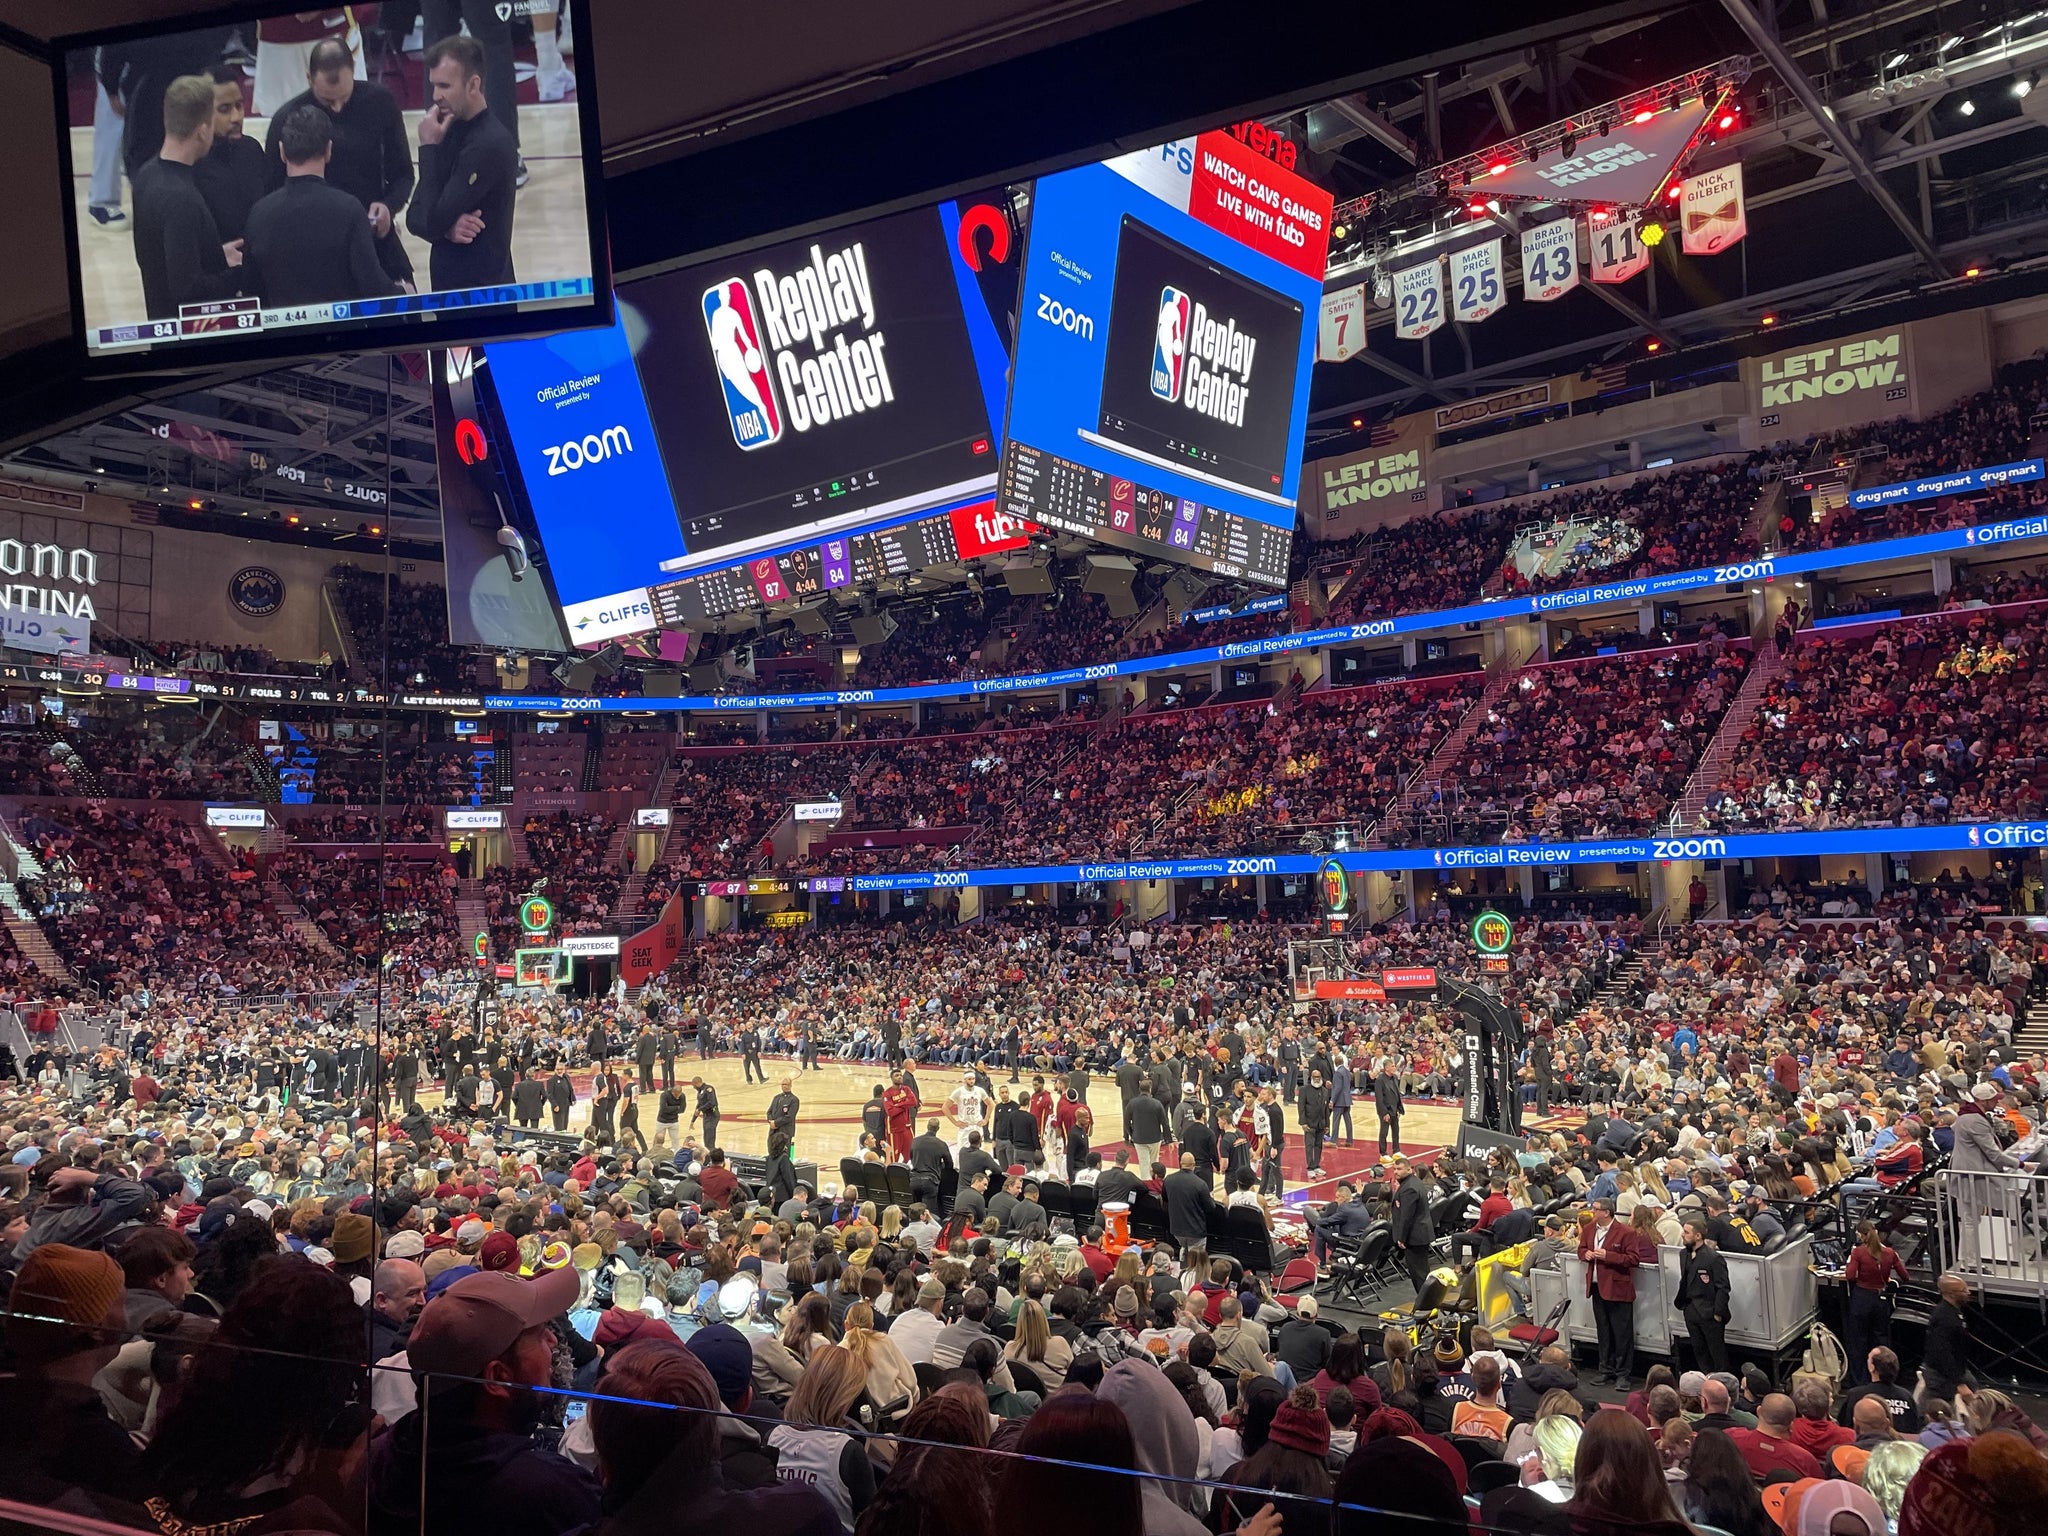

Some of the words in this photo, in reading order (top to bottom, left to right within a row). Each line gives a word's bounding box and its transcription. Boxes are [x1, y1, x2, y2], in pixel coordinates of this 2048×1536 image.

[1535, 157, 1586, 179] LET
[1585, 142, 1635, 163] EM
[1550, 151, 1658, 188] KNOW.
[1696, 173, 1724, 188] NICK
[1204, 152, 1246, 190] WATCH
[1248, 179, 1280, 209] CAVS
[1282, 198, 1322, 231] GAMES
[1688, 180, 1735, 202] GILBERT
[1216, 188, 1242, 216] LIVE
[1244, 202, 1273, 232] WITH
[1275, 217, 1305, 248] fubo
[1534, 226, 1562, 240] BRAD
[1523, 232, 1574, 254] DAUGHERTY
[1600, 226, 1637, 268] 11
[1462, 248, 1490, 264] MARK
[1463, 256, 1490, 274] PRICE
[1050, 250, 1070, 272] Official
[1071, 262, 1092, 281] Review
[1530, 246, 1572, 288] 43
[1403, 267, 1432, 283] LARRY
[1403, 276, 1434, 292] NANCE
[752, 241, 876, 351] Replay
[1458, 267, 1498, 310] 25
[1328, 301, 1354, 316] SMITH
[1400, 288, 1439, 328] 22
[237, 314, 256, 327] 87
[264, 314, 279, 324] 3RD
[284, 311, 307, 322] 4:44
[1037, 294, 1094, 342] zoom
[153, 323, 173, 337] 84
[1334, 314, 1349, 346] 7
[1190, 301, 1256, 382] Replay
[1762, 347, 1832, 382] LET
[1838, 334, 1900, 368] EM
[536, 383, 569, 403] Official
[569, 373, 601, 396] Review
[777, 331, 895, 432] Center
[1153, 368, 1170, 395] NBA
[1762, 360, 1906, 408] KNOW.
[555, 395, 581, 410] presented
[1185, 360, 1250, 428] Center
[1886, 388, 1907, 400] 225
[737, 408, 764, 440] NBA
[1762, 415, 1780, 427] 224
[542, 425, 633, 476] zoom
[1324, 460, 1374, 488] LET
[1378, 449, 1419, 475] EM
[1980, 471, 2006, 482] drug
[2008, 464, 2037, 476] mart
[1326, 469, 1426, 510] KNOW.
[1916, 482, 1942, 494] drug
[1944, 476, 1972, 488] mart
[1136, 491, 1148, 504] 3Q
[1411, 491, 1426, 502] 223
[1856, 492, 1881, 504] drug
[1882, 486, 1908, 498] mart
[1164, 500, 1173, 511] 14
[1114, 509, 1130, 528] 87
[1326, 510, 1340, 520] 222
[1064, 520, 1094, 536] RAFFLE
[1142, 524, 1162, 541] 4:44
[1174, 528, 1188, 546] 84
[1978, 520, 2048, 542] Official
[779, 558, 790, 569] 3Q
[808, 552, 819, 562] 14
[238, 570, 278, 585] CLEVELAND
[829, 568, 844, 584] 84
[1540, 592, 1590, 608] Official
[1594, 582, 1647, 601] Review
[1653, 576, 1696, 589] presented
[1696, 574, 1708, 583] by
[1714, 560, 1774, 583] zoom
[765, 582, 779, 598] 87
[795, 578, 818, 593] 4:44
[238, 600, 278, 614] MONSTERS
[1252, 600, 1268, 610] drug
[1268, 597, 1283, 607] mart
[598, 601, 651, 625] CLIFFS
[1224, 642, 1262, 657] Official
[1264, 636, 1303, 651] Review
[1306, 632, 1337, 642] presented
[1351, 620, 1395, 638] zoom
[4, 668, 17, 677] 14
[40, 671, 62, 681] 4:44
[84, 674, 102, 684] 3Q
[122, 677, 138, 688] 84
[195, 684, 217, 694] FG%
[222, 686, 235, 696] 51
[250, 689, 282, 698] FOULS
[290, 690, 298, 700] 3
[311, 692, 330, 700] TOL
[336, 693, 344, 702] 2
[979, 678, 1014, 691] Official
[1016, 676, 1048, 687] Review
[1084, 664, 1118, 678] zoom
[444, 697, 480, 706] KNOW.
[561, 698, 601, 708] zoom
[720, 698, 757, 708] Official
[758, 696, 795, 706] Review
[836, 690, 874, 702] zoom
[1444, 849, 1503, 865] Official
[1508, 847, 1571, 863] Review
[1579, 846, 1630, 857] presented
[1632, 846, 1646, 856] by
[1652, 838, 1726, 858] zoom
[1086, 866, 1126, 879] Official
[1129, 864, 1172, 877] Review
[1178, 864, 1212, 872] presented
[1213, 864, 1222, 872] by
[1226, 858, 1276, 874] zoom
[727, 884, 741, 894] 87
[768, 882, 789, 892] 4:44
[816, 880, 828, 890] 84
[856, 878, 894, 889] Review
[934, 872, 969, 886] zoom
[1329, 883, 1341, 905] 14
[533, 912, 545, 926] 14
[666, 924, 676, 936] SEAT
[567, 942, 614, 951] TRUSTEDSEC
[665, 936, 676, 949] GEEK
[1488, 933, 1502, 946] 14
[632, 948, 652, 958] SEAT
[631, 958, 653, 968] GEEK
[1396, 974, 1432, 982] WESTFIELD
[1469, 1051, 1479, 1094] Cleveland
[966, 1106, 975, 1116] 22
[1470, 1094, 1480, 1119] Clinic
